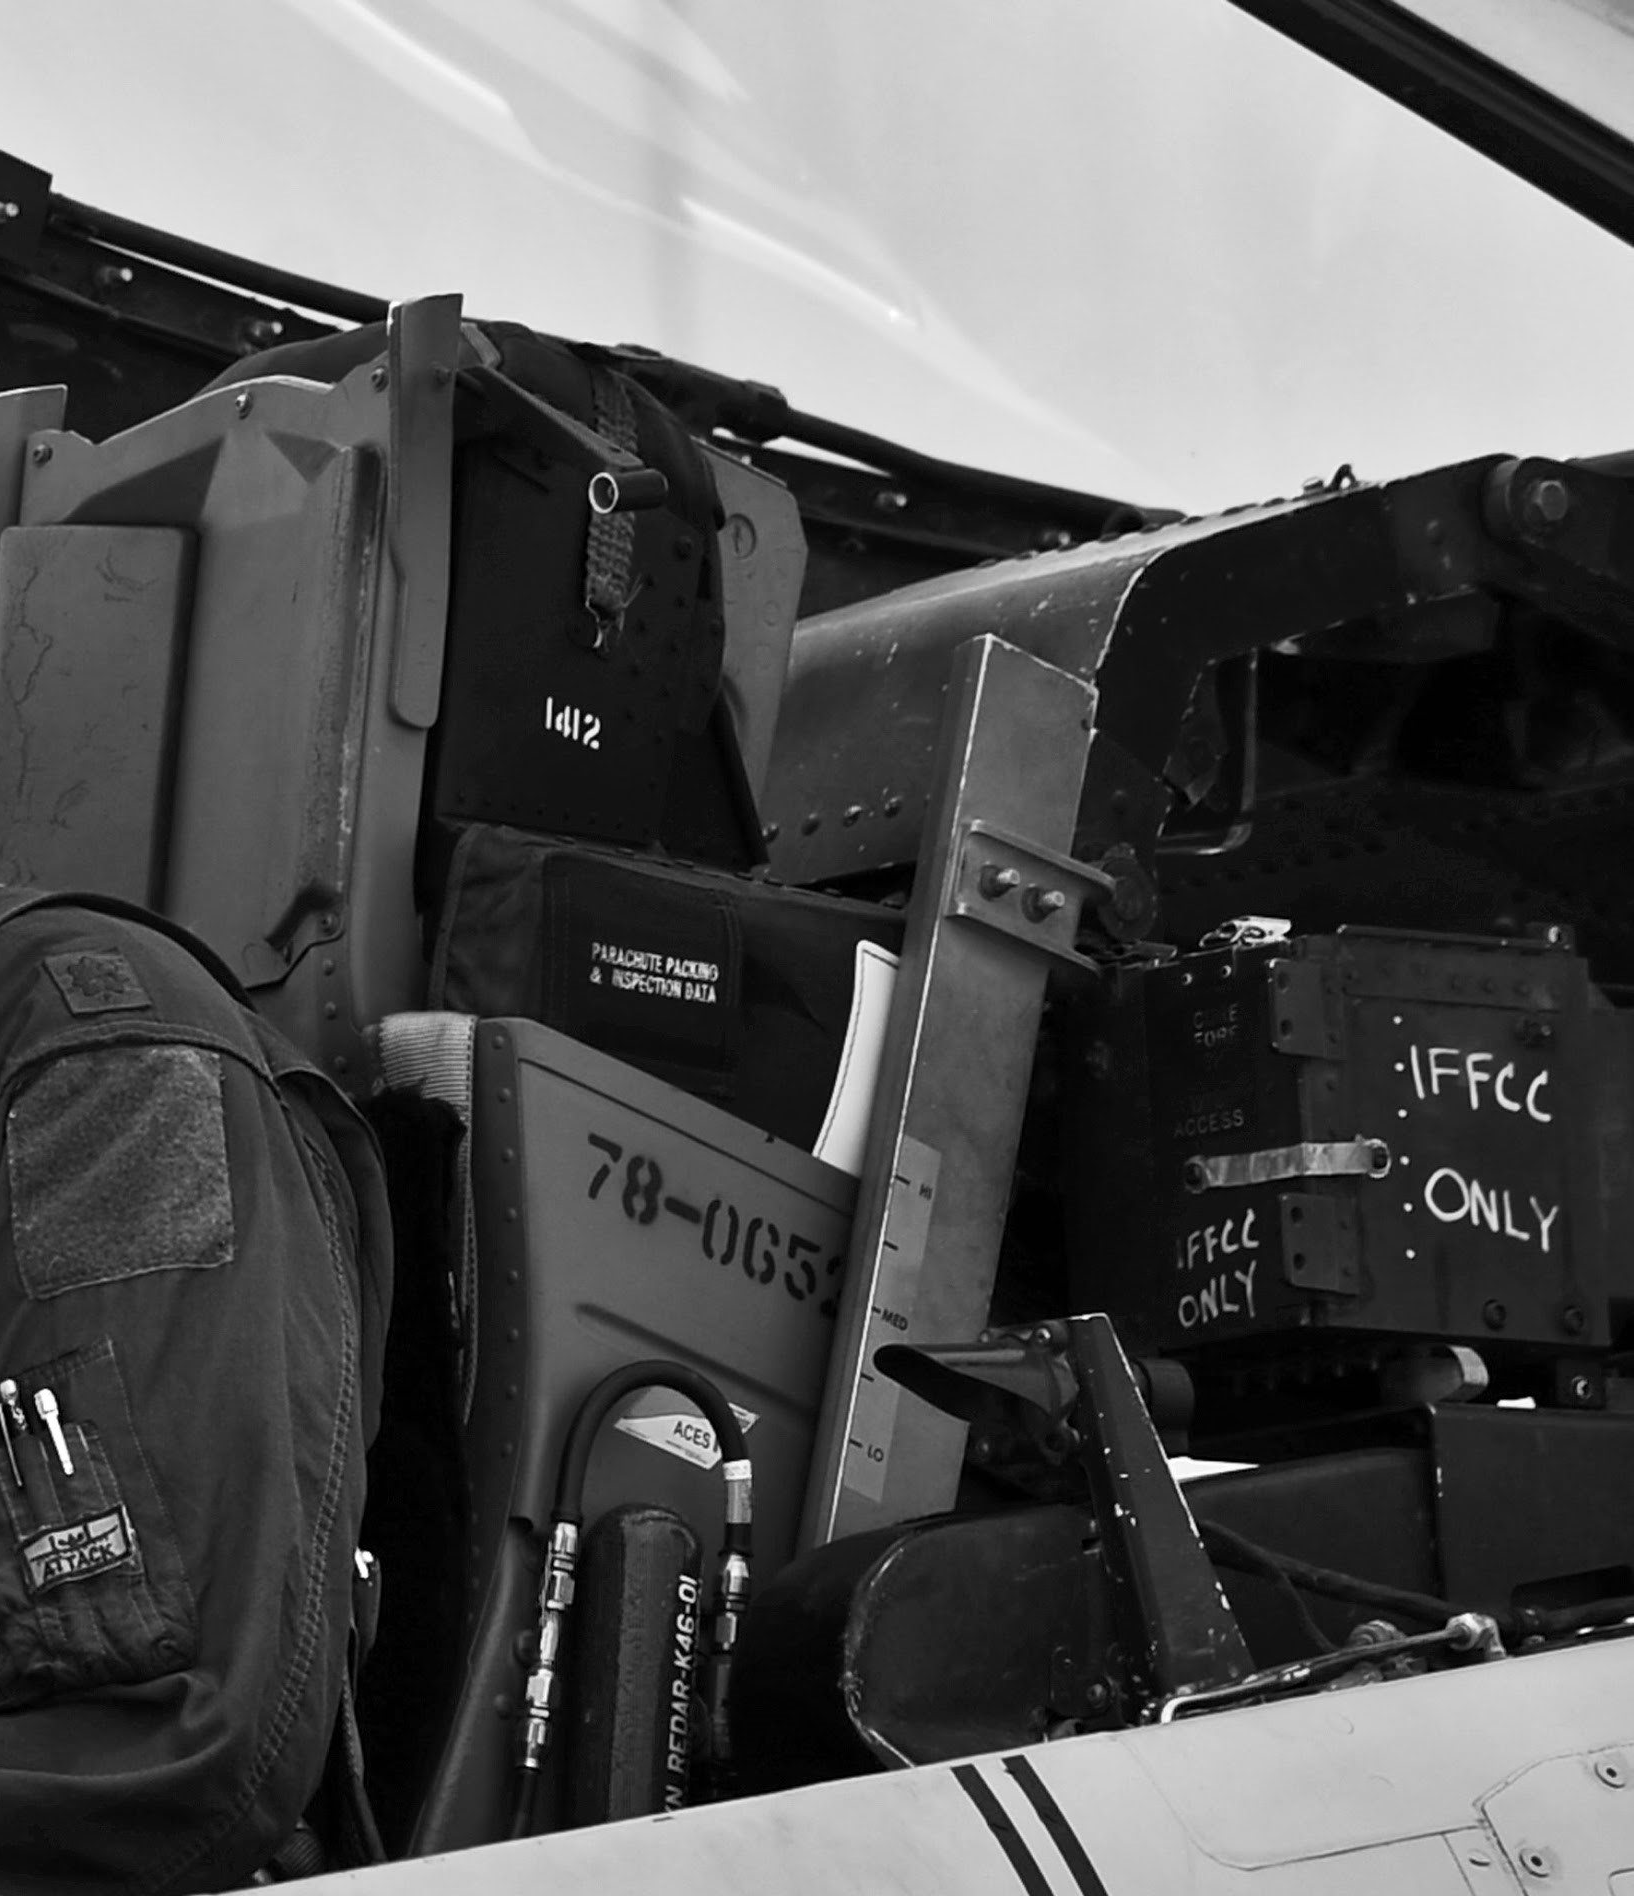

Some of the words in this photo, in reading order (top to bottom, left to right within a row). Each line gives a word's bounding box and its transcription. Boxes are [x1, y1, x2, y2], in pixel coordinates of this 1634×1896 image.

[591, 941, 663, 975] PARACHUTE
[665, 956, 719, 982] PACKING
[589, 966, 603, 985] &
[612, 968, 682, 999] INSPECTION
[684, 981, 717, 1003] DATA
[1409, 1044, 1553, 1123] IFFCC
[1172, 1108, 1245, 1139] ACCESS
[1424, 1167, 1559, 1253] ONLY
[1175, 1207, 1260, 1270] IFFCC
[1177, 1258, 1258, 1328] ONLY
[881, 1307, 909, 1332] MED
[673, 1420, 712, 1450] ACES
[866, 1444, 885, 1464] LO
[43, 1543, 116, 1579] ATTACK
